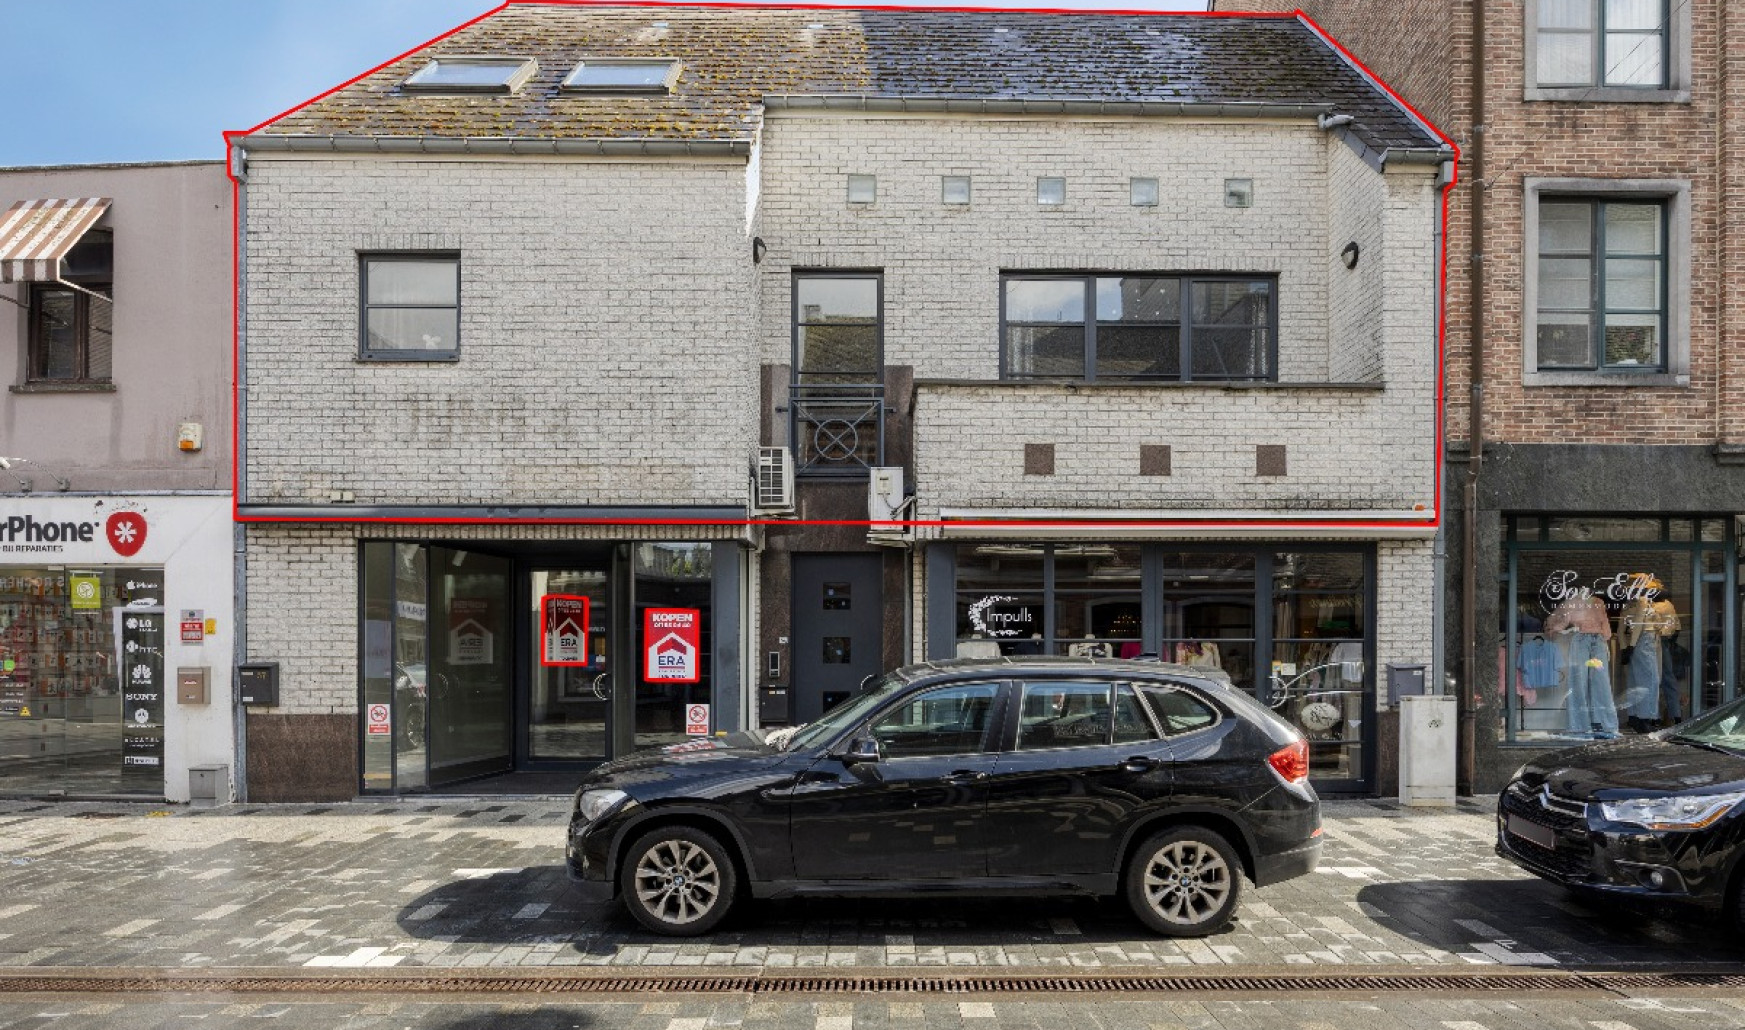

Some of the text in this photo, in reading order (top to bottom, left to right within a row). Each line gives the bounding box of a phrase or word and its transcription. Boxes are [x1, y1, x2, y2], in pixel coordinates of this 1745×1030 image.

[652, 613, 693, 622] KOPEN
[986, 606, 1032, 628] Impulls
[139, 619, 152, 628] LG
[560, 638, 578, 647] ERA
[658, 655, 686, 666] ERA
[125, 693, 158, 701] SONY
